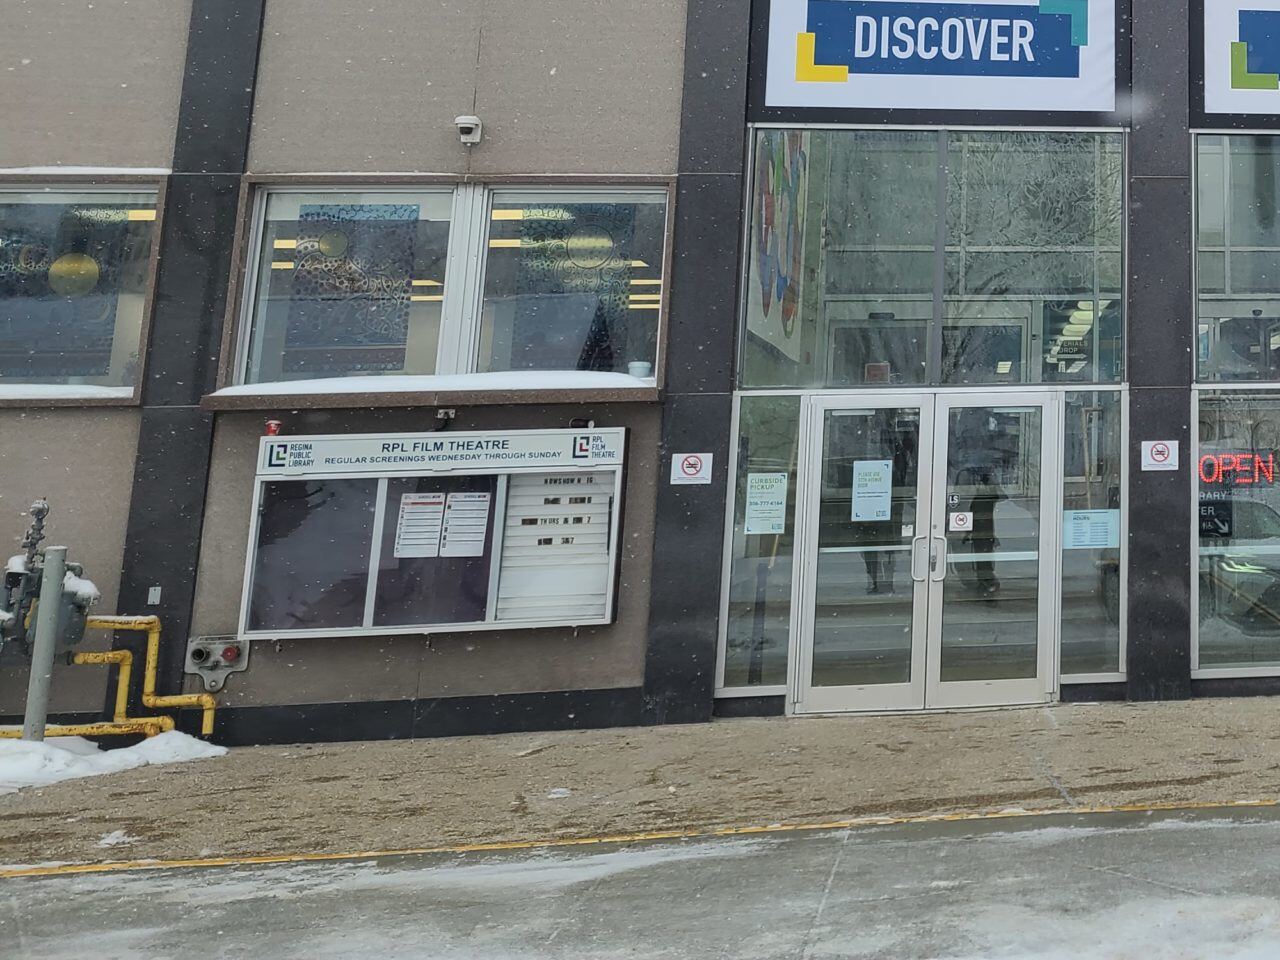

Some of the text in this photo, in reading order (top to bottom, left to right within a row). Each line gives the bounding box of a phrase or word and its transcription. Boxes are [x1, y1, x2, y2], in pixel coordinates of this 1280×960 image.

[853, 16, 1035, 62] DISCOVER
[592, 435, 604, 443] RPL
[290, 443, 313, 451] REGINA
[381, 439, 509, 453] RPL FILM THEATRE
[592, 443, 606, 451] FILM
[289, 451, 312, 459] PUBLIC
[324, 451, 562, 465] REGULAR SCREENINGS WEDNESDAY THROUGH SUNDAY
[591, 450, 616, 459] THEATRE
[288, 459, 315, 467] LIBRARY
[1198, 452, 1275, 484] OPEN
[949, 495, 959, 504] LS
